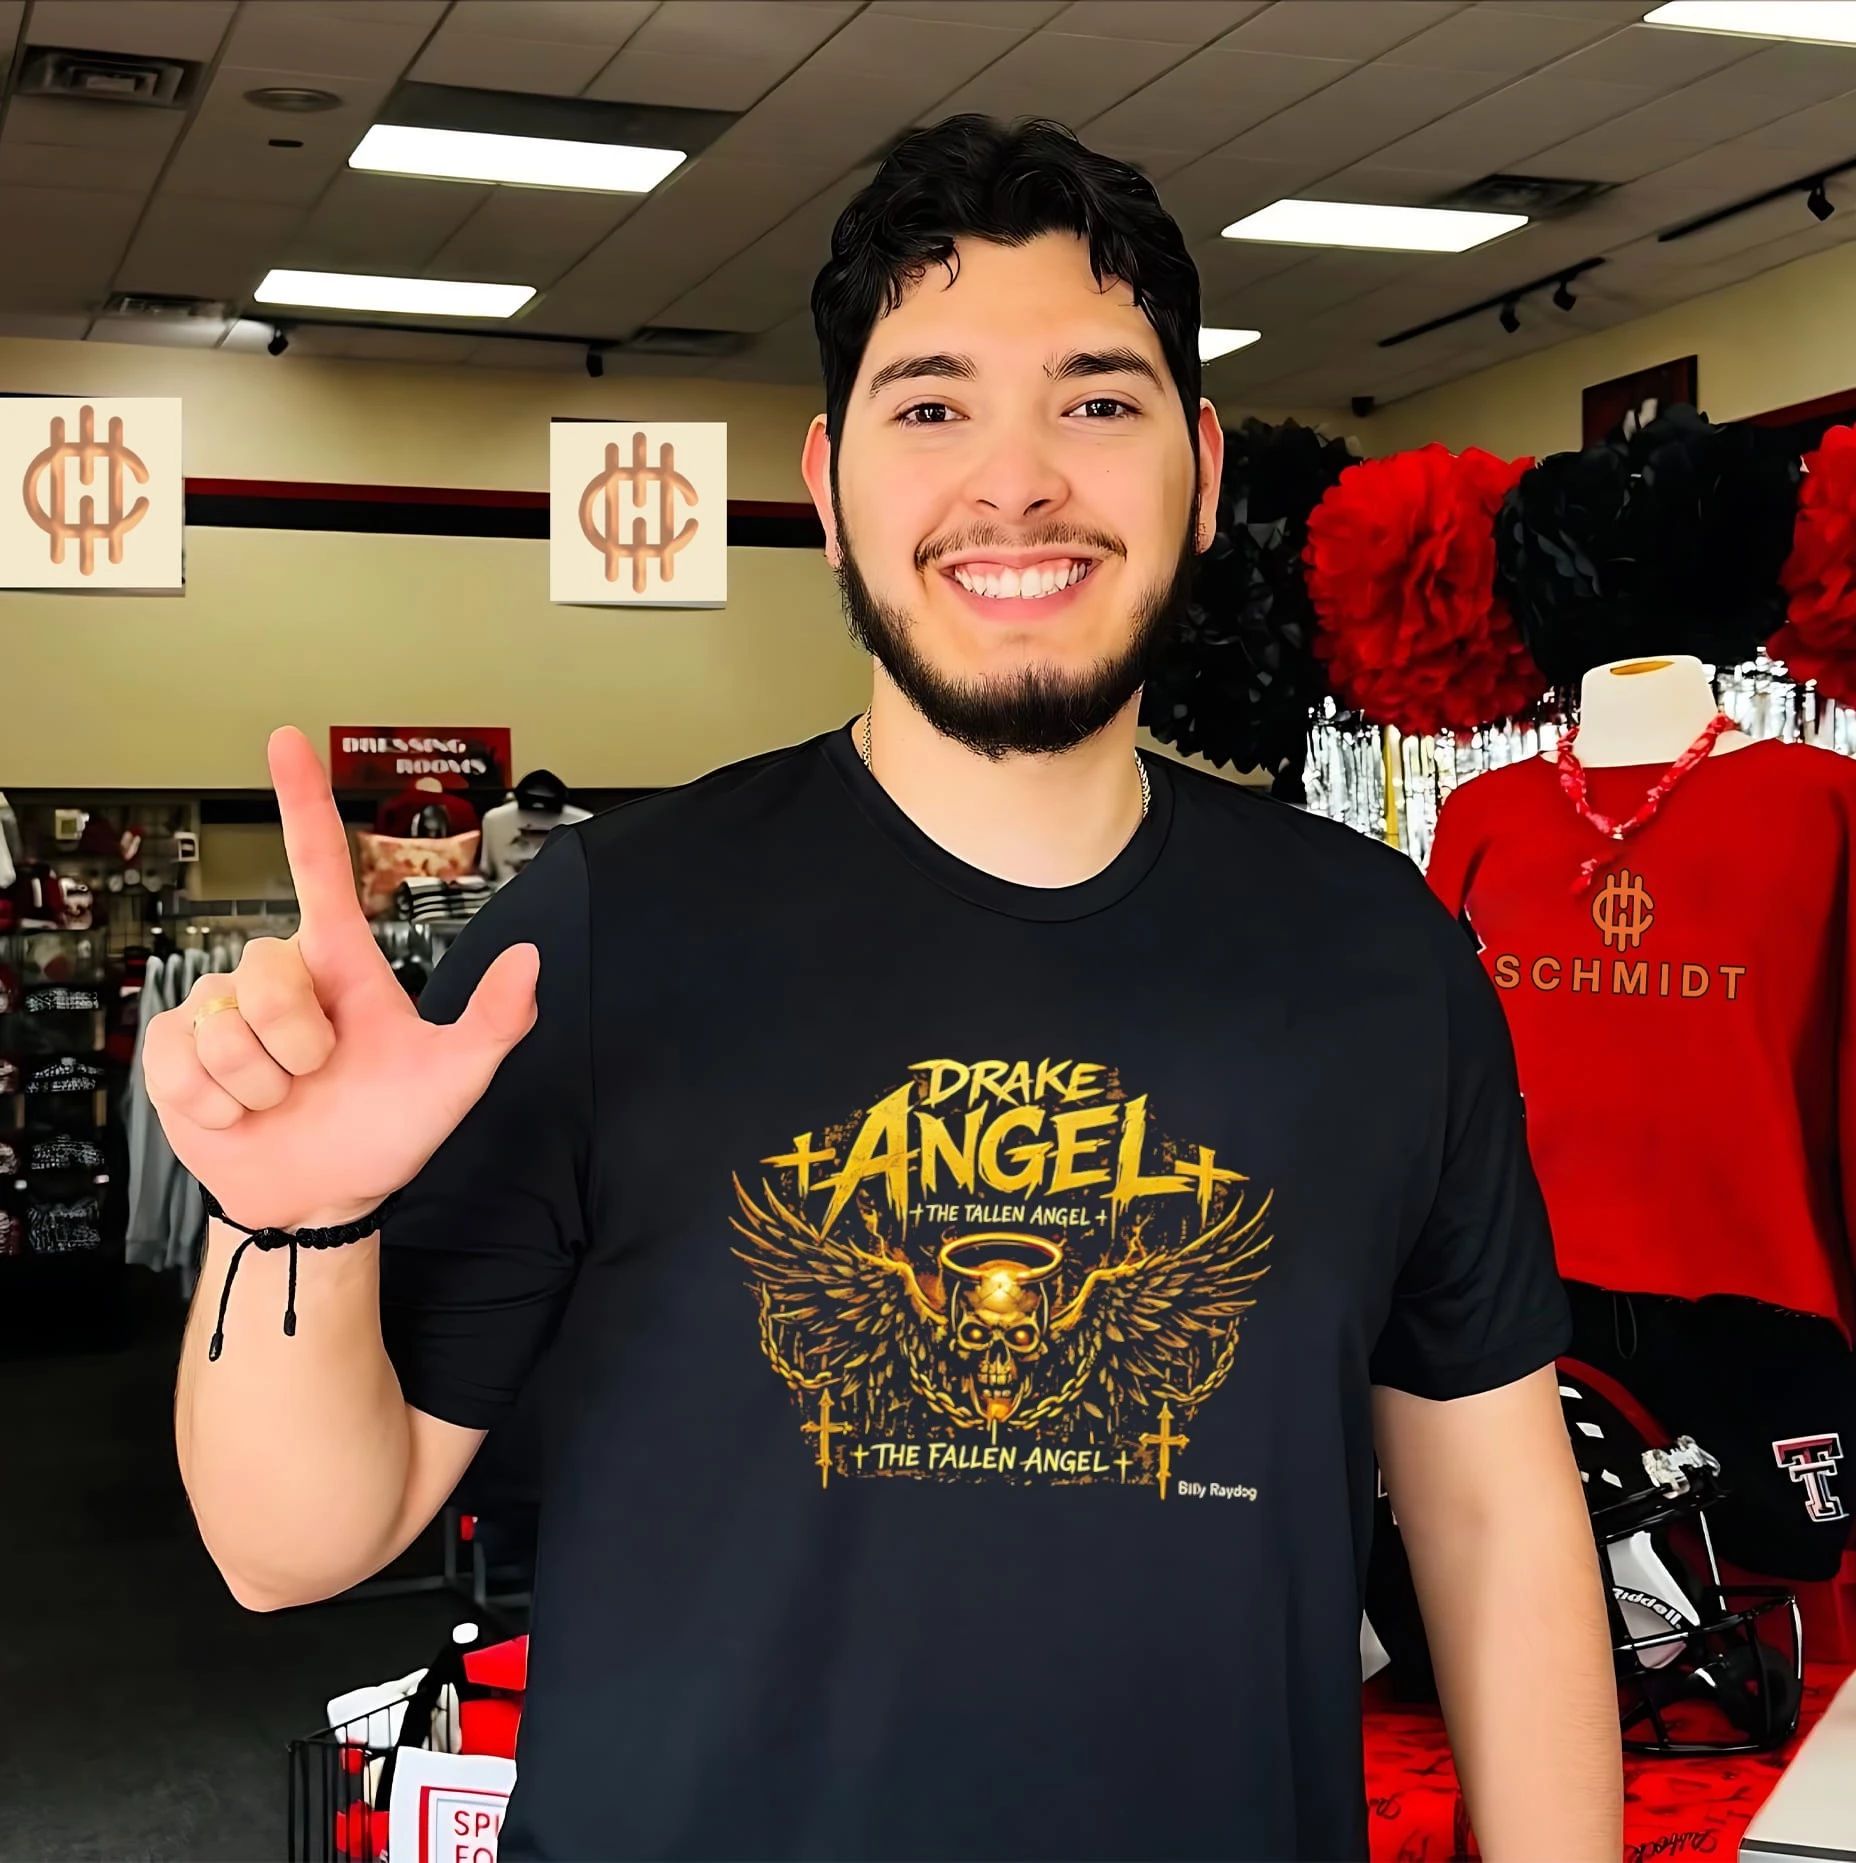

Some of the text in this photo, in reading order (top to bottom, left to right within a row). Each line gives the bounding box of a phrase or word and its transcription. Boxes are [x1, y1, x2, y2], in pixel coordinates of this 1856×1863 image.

[1494, 954, 1747, 1000] SCHMIDT
[908, 1057, 1107, 1107] DRAKE
[810, 1080, 1197, 1244] ANGEL
[926, 1204, 1091, 1228] THE TALLEN ANGEL
[870, 1442, 1110, 1475] THE FALLEN ANGEL
[1178, 1480, 1258, 1501] Billy Raydog
